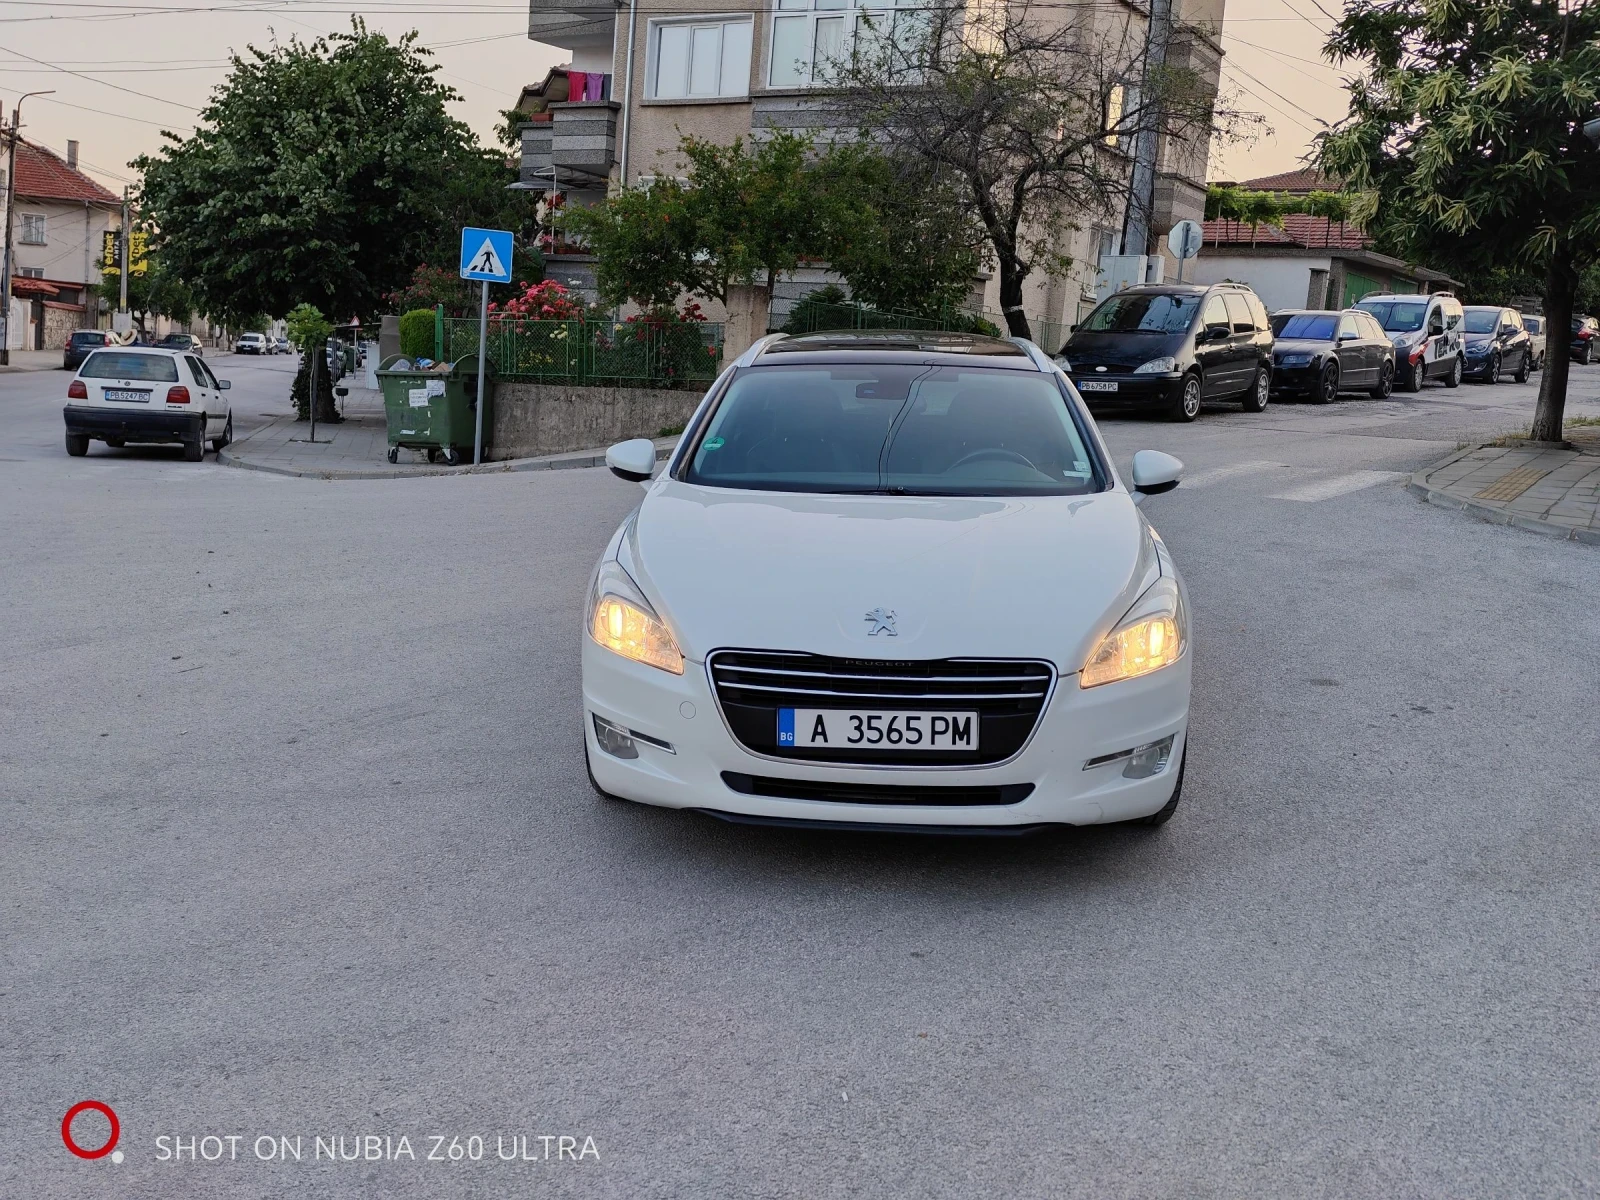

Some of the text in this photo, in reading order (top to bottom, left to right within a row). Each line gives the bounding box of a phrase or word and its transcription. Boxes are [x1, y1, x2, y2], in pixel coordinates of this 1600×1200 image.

[120, 392, 137, 400] 5247
[845, 659, 914, 667] PEUGEOT
[811, 714, 971, 746] A 3565 PM
[780, 732, 793, 741] BG
